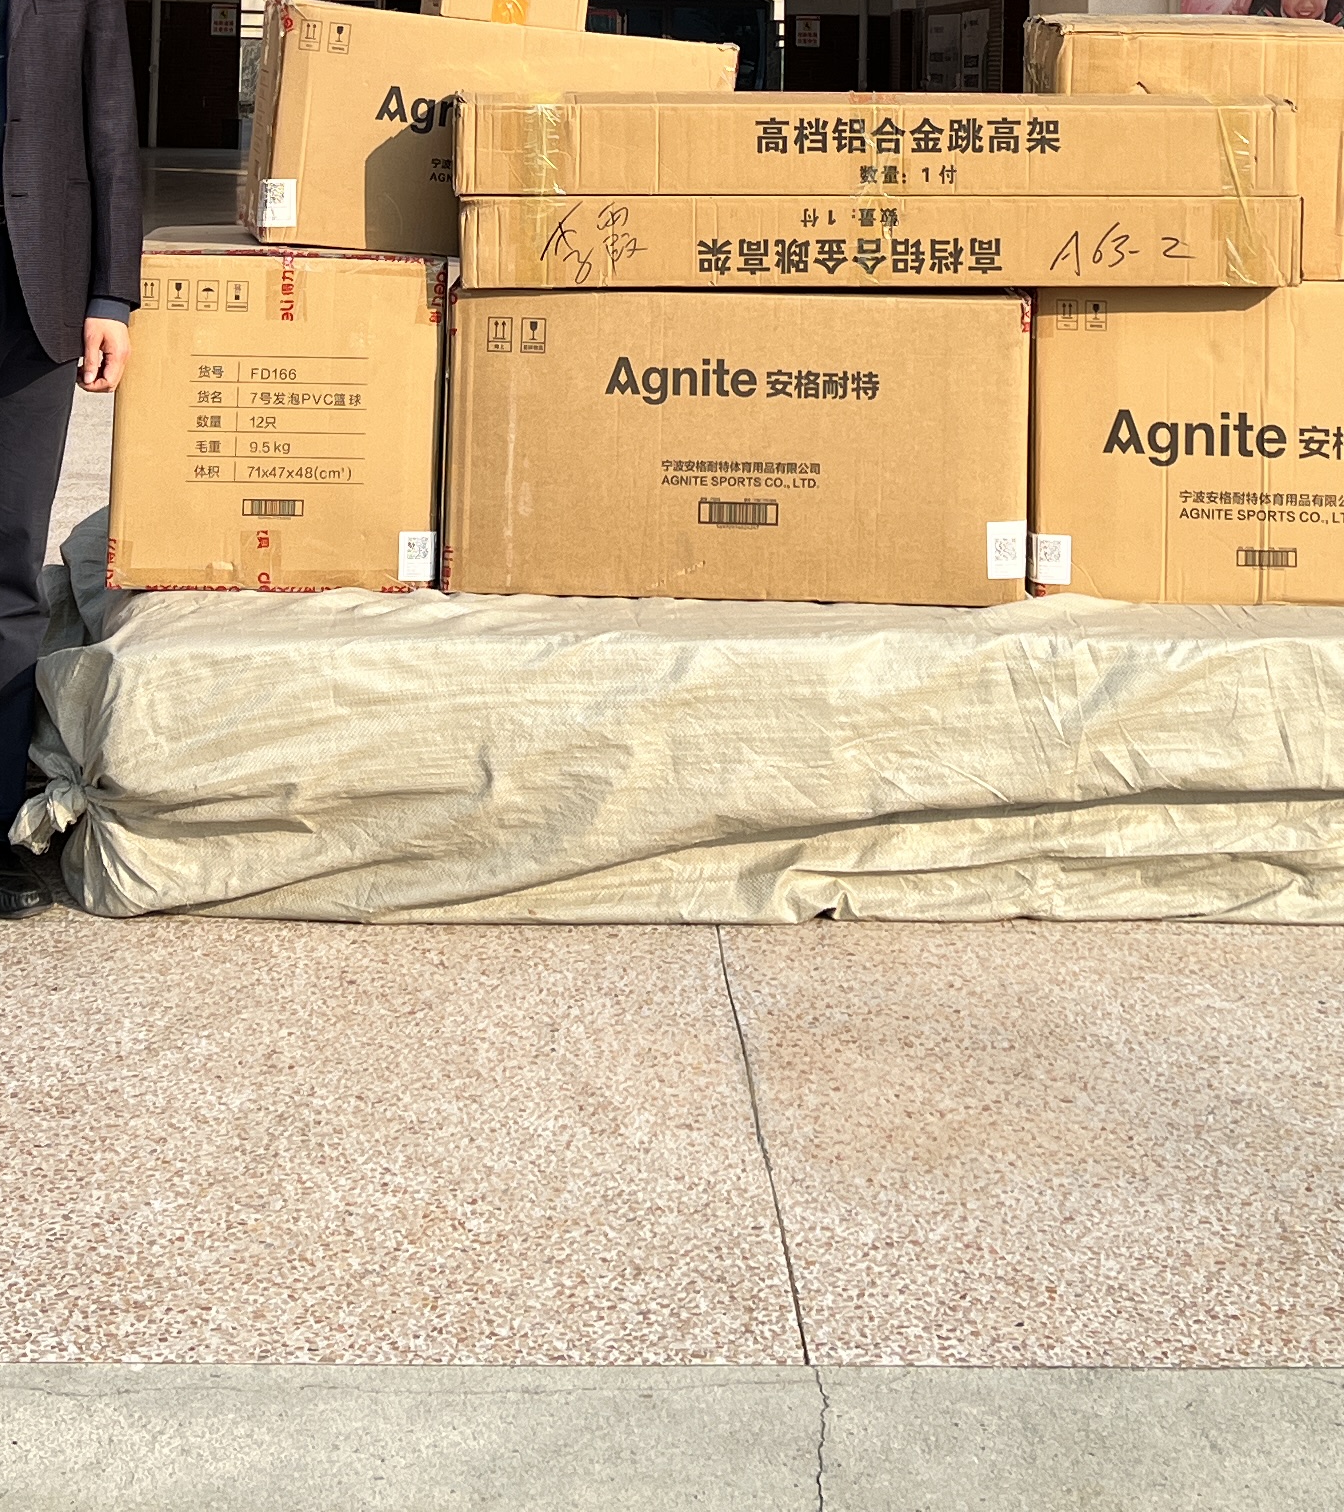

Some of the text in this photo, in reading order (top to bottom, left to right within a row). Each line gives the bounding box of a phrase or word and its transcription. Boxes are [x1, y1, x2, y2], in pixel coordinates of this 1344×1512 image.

[375, 86, 455, 134] Agn
[755, 116, 1062, 155] 高档铝合金跳高架
[697, 238, 1003, 275] 高档铝合金跳高架
[198, 365, 297, 381] 货号 FD166
[605, 356, 880, 405] Agnite 安格耐特
[197, 391, 223, 404] 货名
[196, 415, 277, 429] 数量 12只
[1102, 409, 1287, 467] Agnite
[195, 440, 221, 453] 毛重
[194, 465, 220, 478] 体积
[661, 459, 821, 475] 宁波安格耐特体育用品有限公司
[661, 475, 709, 487] AGNITE
[710, 476, 761, 488] SPORTS
[1179, 508, 1233, 521] AGNITE
[1236, 509, 1296, 522] SPORTS
